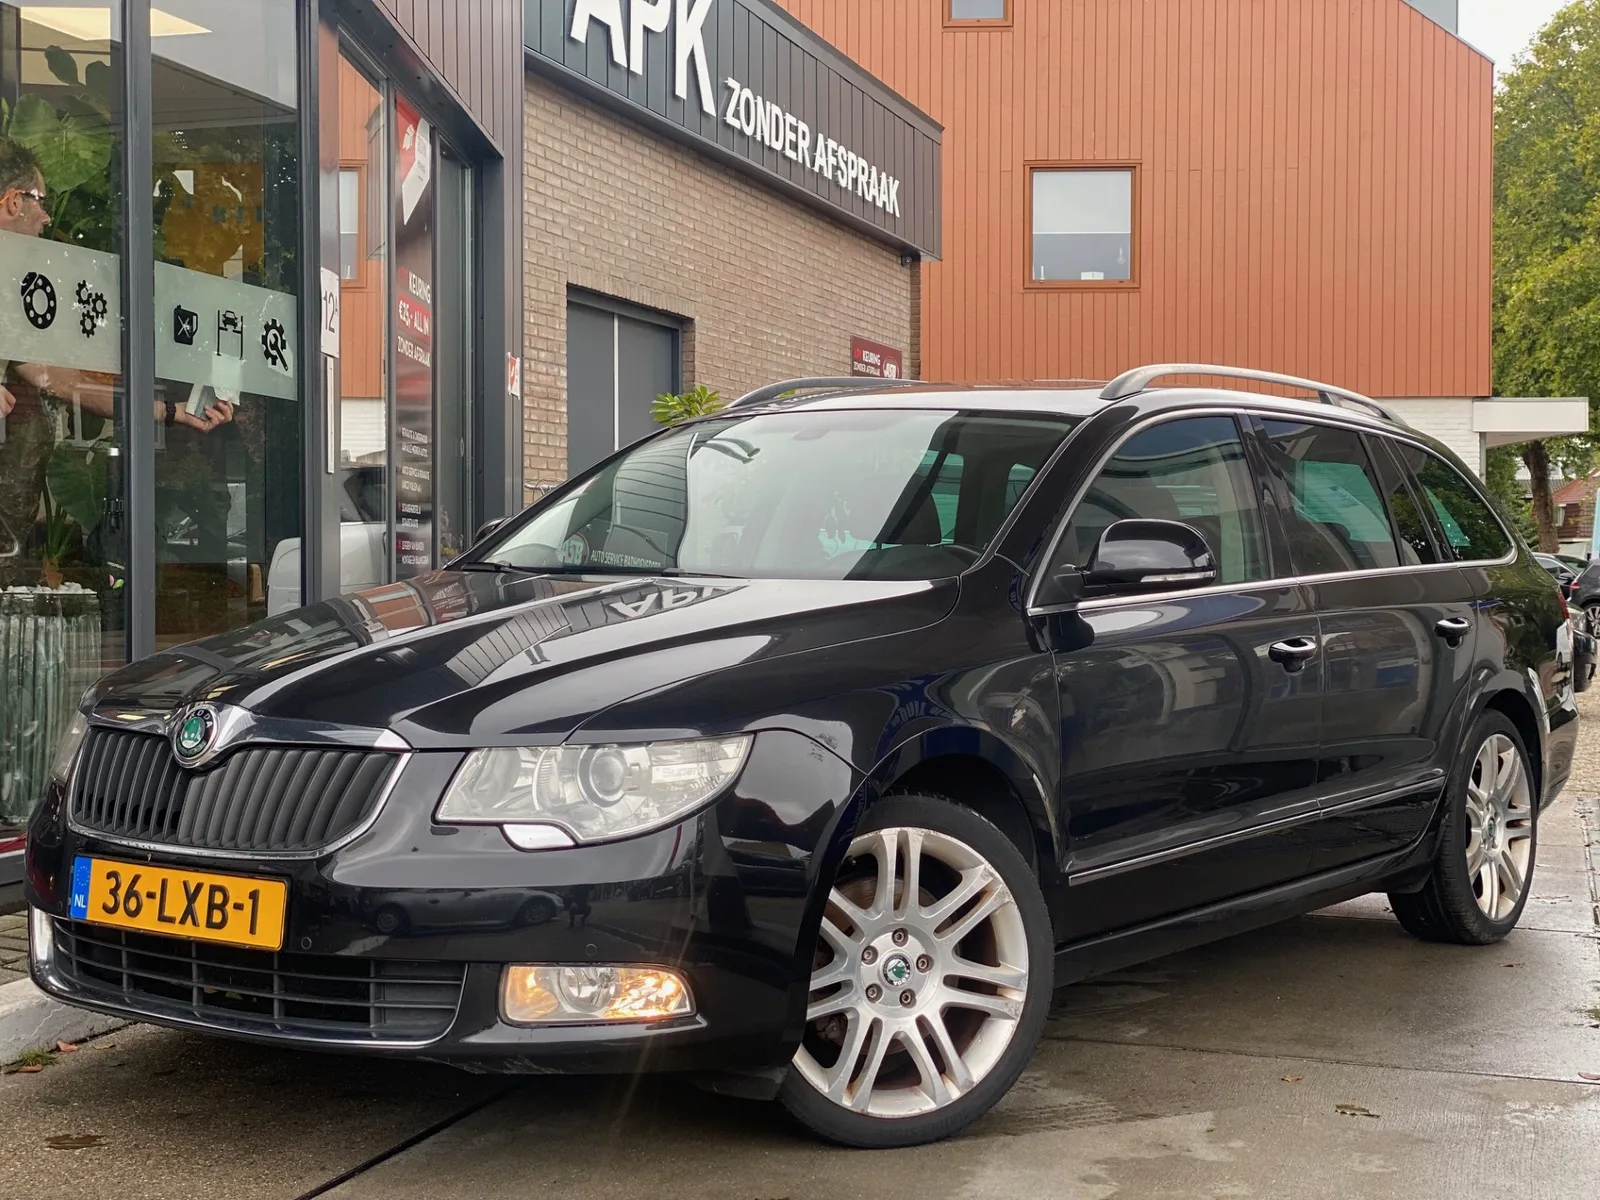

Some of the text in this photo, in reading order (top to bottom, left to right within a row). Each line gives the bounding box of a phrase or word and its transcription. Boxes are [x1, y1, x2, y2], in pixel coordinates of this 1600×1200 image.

[571, 0, 717, 117] APK
[726, 76, 901, 218] ZONDER AFSPRAAK
[408, 270, 431, 304] KEURING
[590, 549, 605, 564] AUTO
[74, 894, 86, 908] NL
[102, 869, 260, 936] 36-LXB-1
